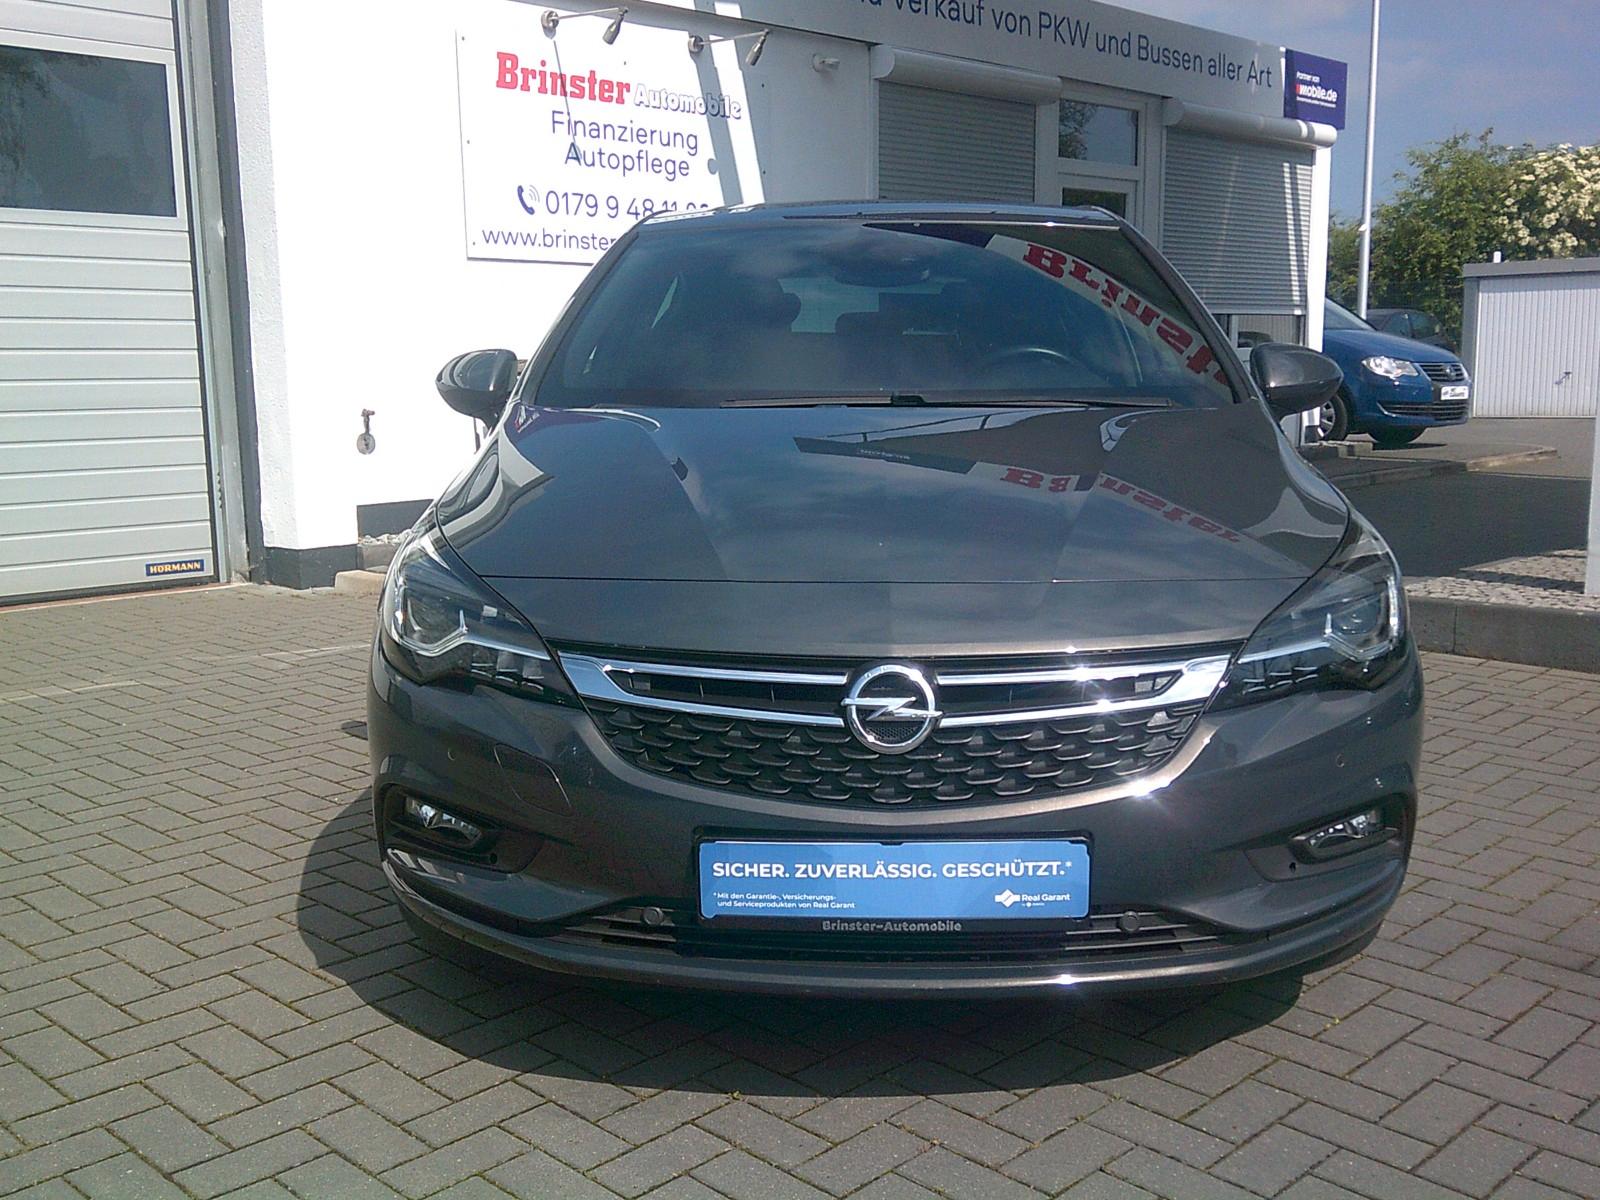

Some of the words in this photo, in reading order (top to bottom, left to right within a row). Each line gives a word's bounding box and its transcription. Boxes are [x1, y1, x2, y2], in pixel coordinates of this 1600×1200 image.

[992, 8, 1031, 37] von
[1039, 11, 1090, 49] PKW
[1096, 32, 1131, 58] und
[1138, 34, 1203, 74] Bussen
[1208, 52, 1243, 81] aller
[1246, 60, 1272, 88] Art
[496, 51, 631, 105] Brinster
[633, 82, 742, 120] Automobile
[551, 110, 698, 157] Finanzierung
[564, 141, 690, 182] Autopflege
[545, 189, 599, 218] 0179
[606, 195, 620, 219] 9
[626, 197, 655, 221] 48
[712, 862, 790, 878] SICHER.
[794, 861, 938, 879] ZUVERLÄSSIG.
[730, 892, 745, 900] den
[783, 893, 837, 902] Versicherungs-
[733, 901, 797, 909] Serviceprodukten
[830, 902, 856, 910] Garant
[1021, 894, 1041, 902] Real
[1041, 893, 1071, 902] Garant
[822, 920, 962, 933] Brinster-Automobile
